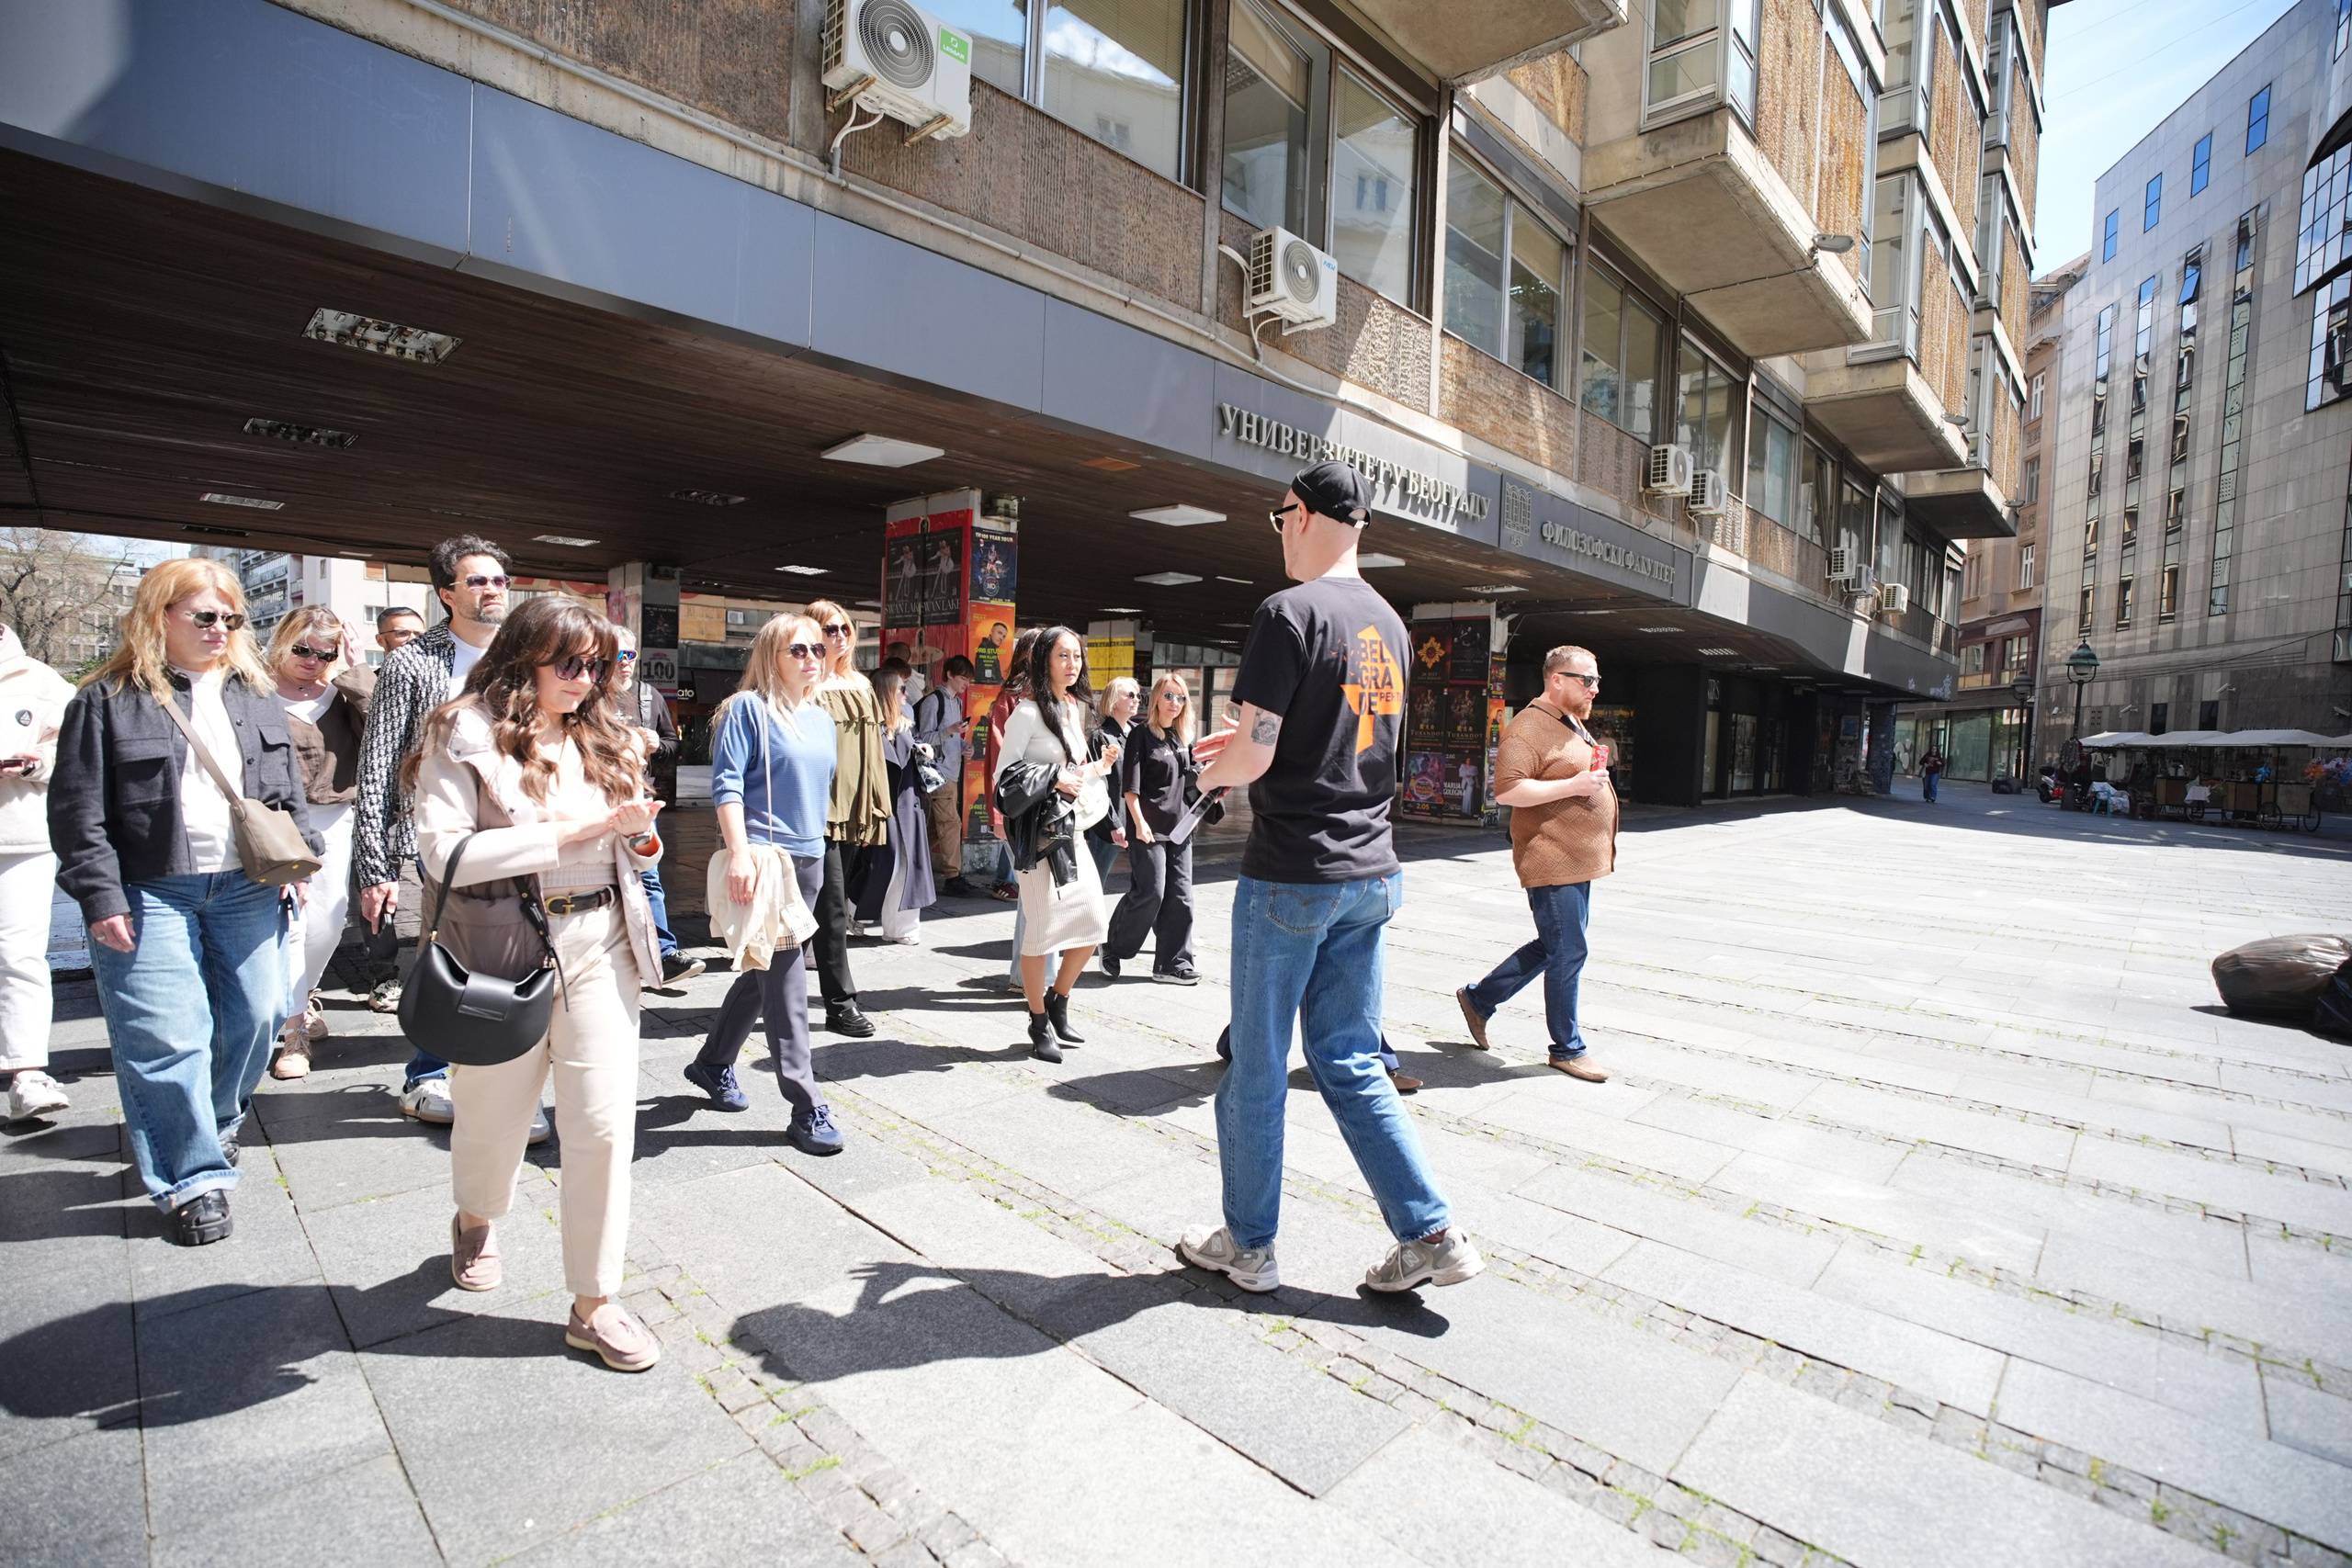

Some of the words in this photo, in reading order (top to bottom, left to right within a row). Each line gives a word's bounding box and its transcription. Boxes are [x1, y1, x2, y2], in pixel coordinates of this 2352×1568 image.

[943, 44, 965, 61] LESSAR
[1406, 469, 1492, 523] БЕОГРАДУ
[1542, 520, 1625, 568] ФИЛОЗОФСКИ
[885, 602, 904, 614] SWAN
[942, 598, 960, 611] LAKE
[1359, 638, 1390, 663] BEL
[643, 661, 675, 680] 100
[1359, 665, 1394, 689] GRA
[1359, 692, 1379, 715] DE
[1212, 1237, 1222, 1251] N
[1402, 1250, 1419, 1268] N
